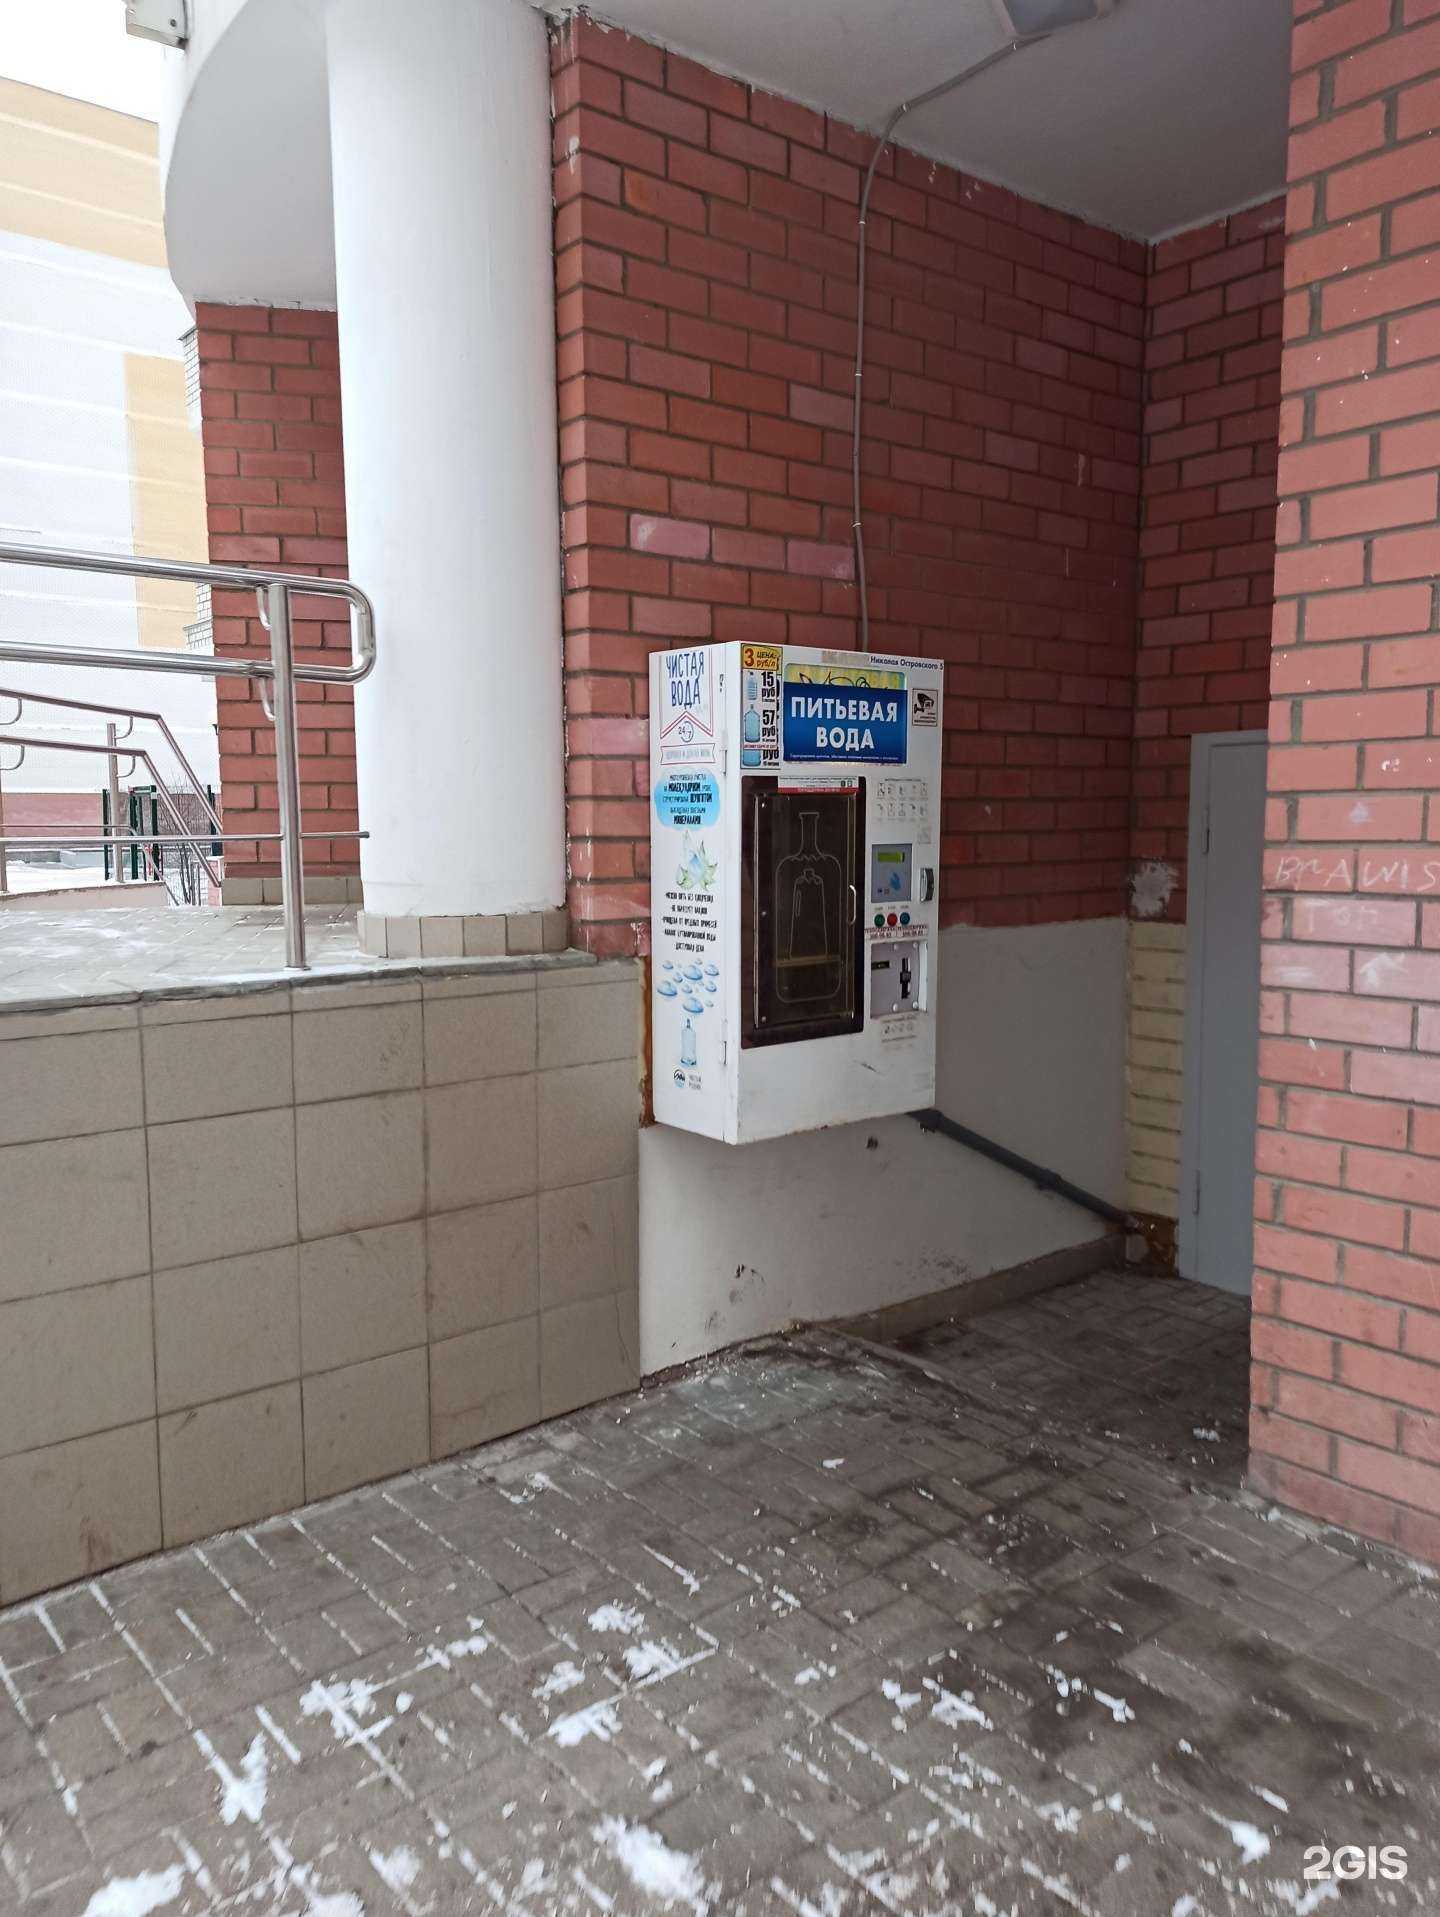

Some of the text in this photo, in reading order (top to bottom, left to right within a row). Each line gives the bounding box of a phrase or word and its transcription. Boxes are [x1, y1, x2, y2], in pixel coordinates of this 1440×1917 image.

[666, 652, 704, 679] ЧИСТАЯ
[744, 648, 755, 667] 3
[757, 659, 775, 668] руб/л
[900, 658, 940, 670] Островского
[761, 671, 774, 687] 15
[671, 679, 701, 710] ВОДА
[762, 687, 776, 698] руб
[763, 710, 775, 725] 57
[791, 696, 898, 723] ПИТЬЕВАЯ
[762, 726, 776, 737] руб
[816, 726, 875, 752] ВОДА
